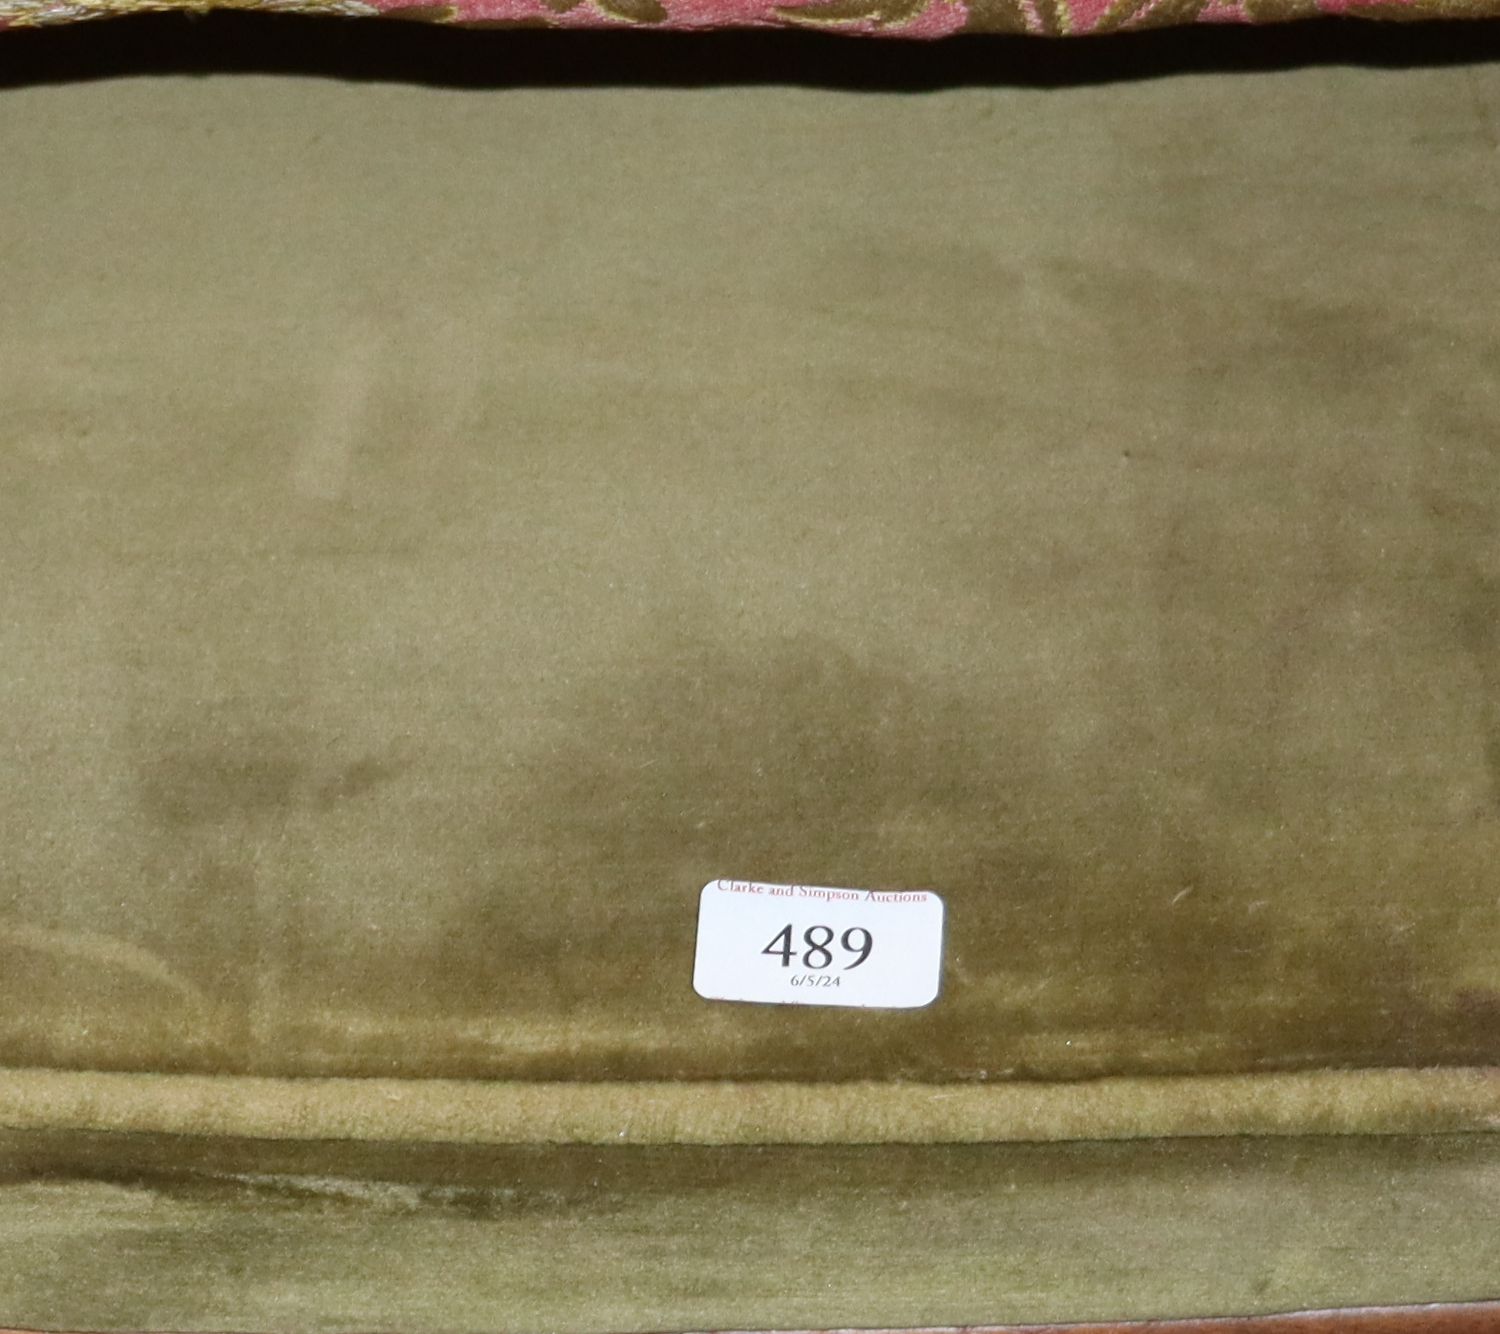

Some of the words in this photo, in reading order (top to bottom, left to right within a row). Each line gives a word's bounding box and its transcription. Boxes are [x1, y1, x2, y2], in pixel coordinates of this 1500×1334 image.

[717, 879, 764, 894] Clarke
[769, 884, 794, 896] and
[799, 885, 859, 902] Simpson
[864, 890, 928, 903] Auctions
[761, 923, 873, 971] 489
[790, 974, 841, 988] 6/5/24
